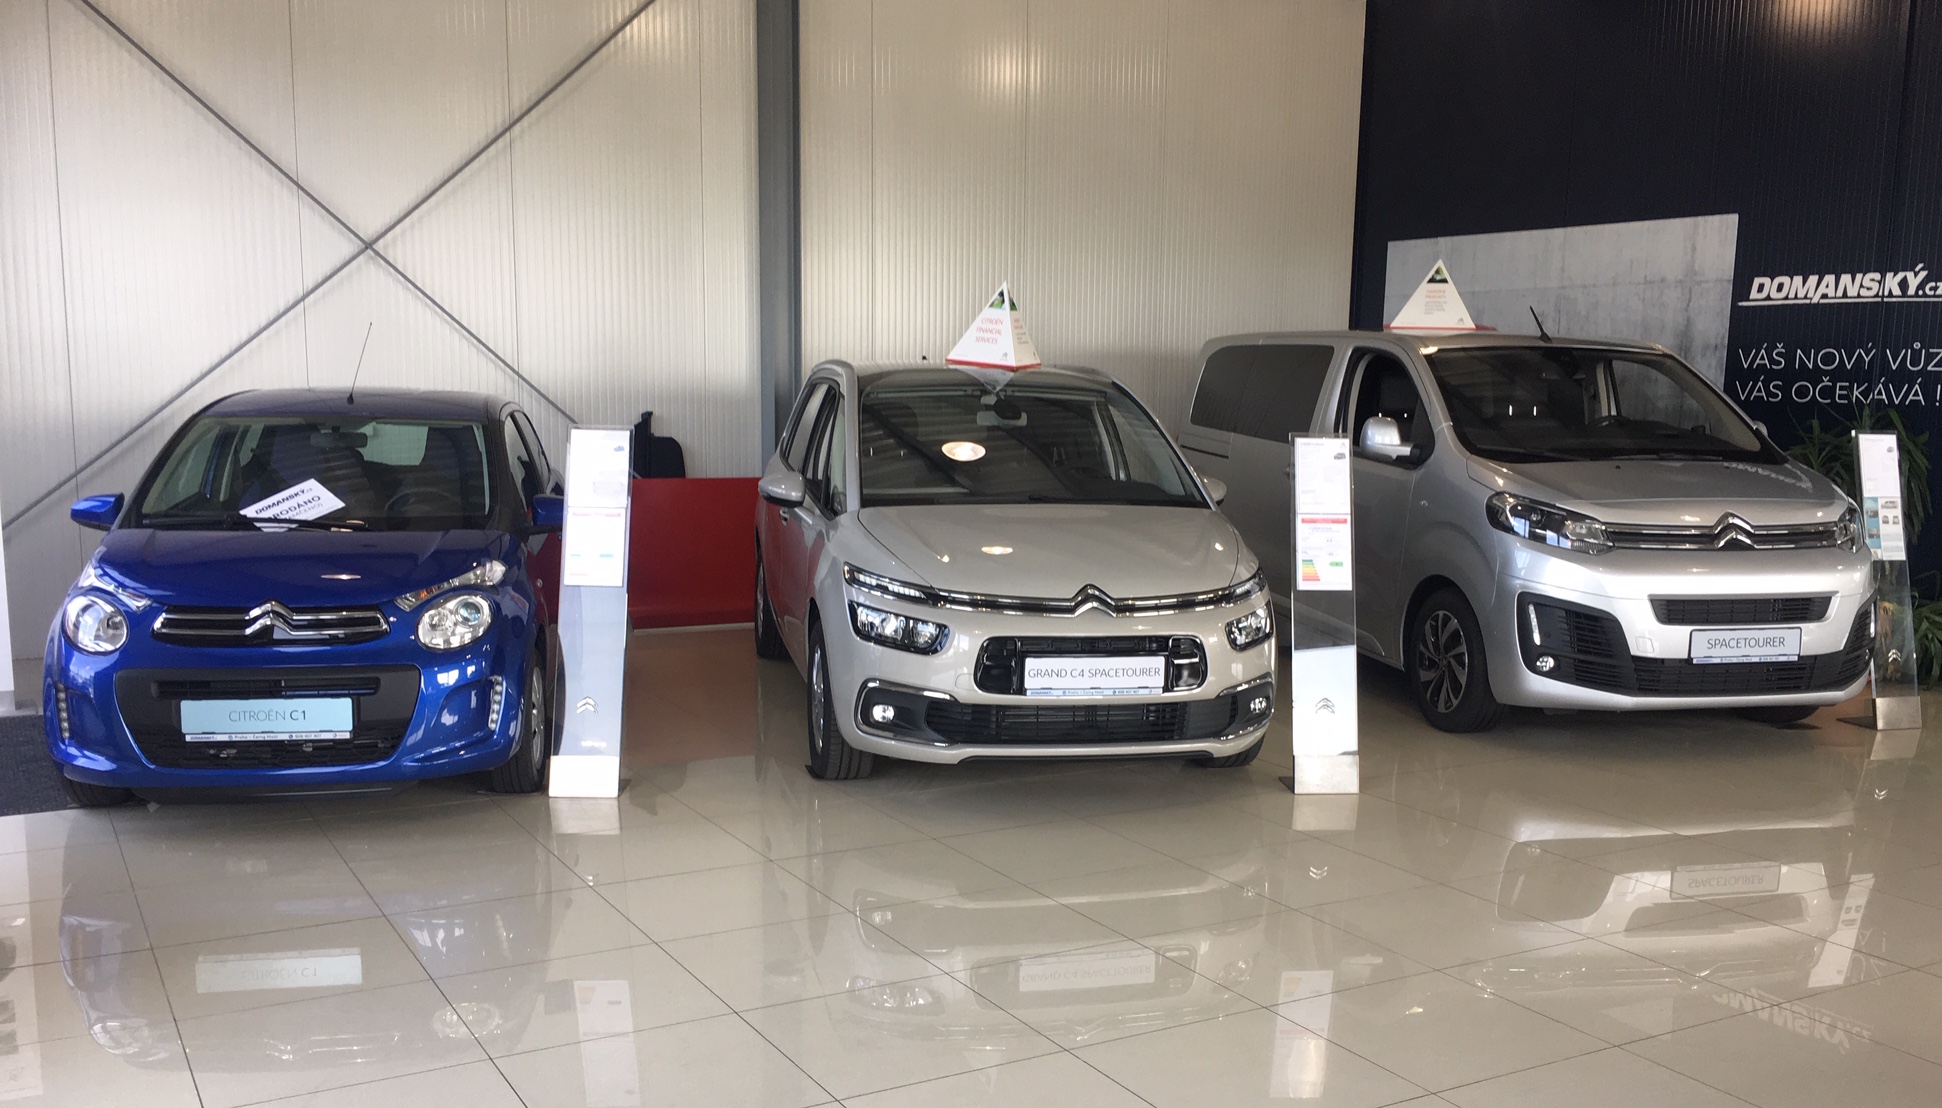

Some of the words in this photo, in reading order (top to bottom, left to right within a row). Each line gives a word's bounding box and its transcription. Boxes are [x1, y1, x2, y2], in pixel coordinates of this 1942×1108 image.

[1739, 343, 1785, 369] VÁŠ
[1796, 342, 1875, 370] NOVÝ
[1887, 342, 1942, 371] VŮZ
[1736, 375, 1782, 402] VÁS
[1791, 376, 1925, 406] OČEKÁVÁ
[272, 495, 321, 519] RODÁNO
[1707, 637, 1786, 650] SPACETOURER
[1028, 668, 1067, 678] GRAND
[1070, 668, 1085, 678] C4
[1088, 667, 1161, 678] SPACETOURER
[289, 710, 307, 721] C1
